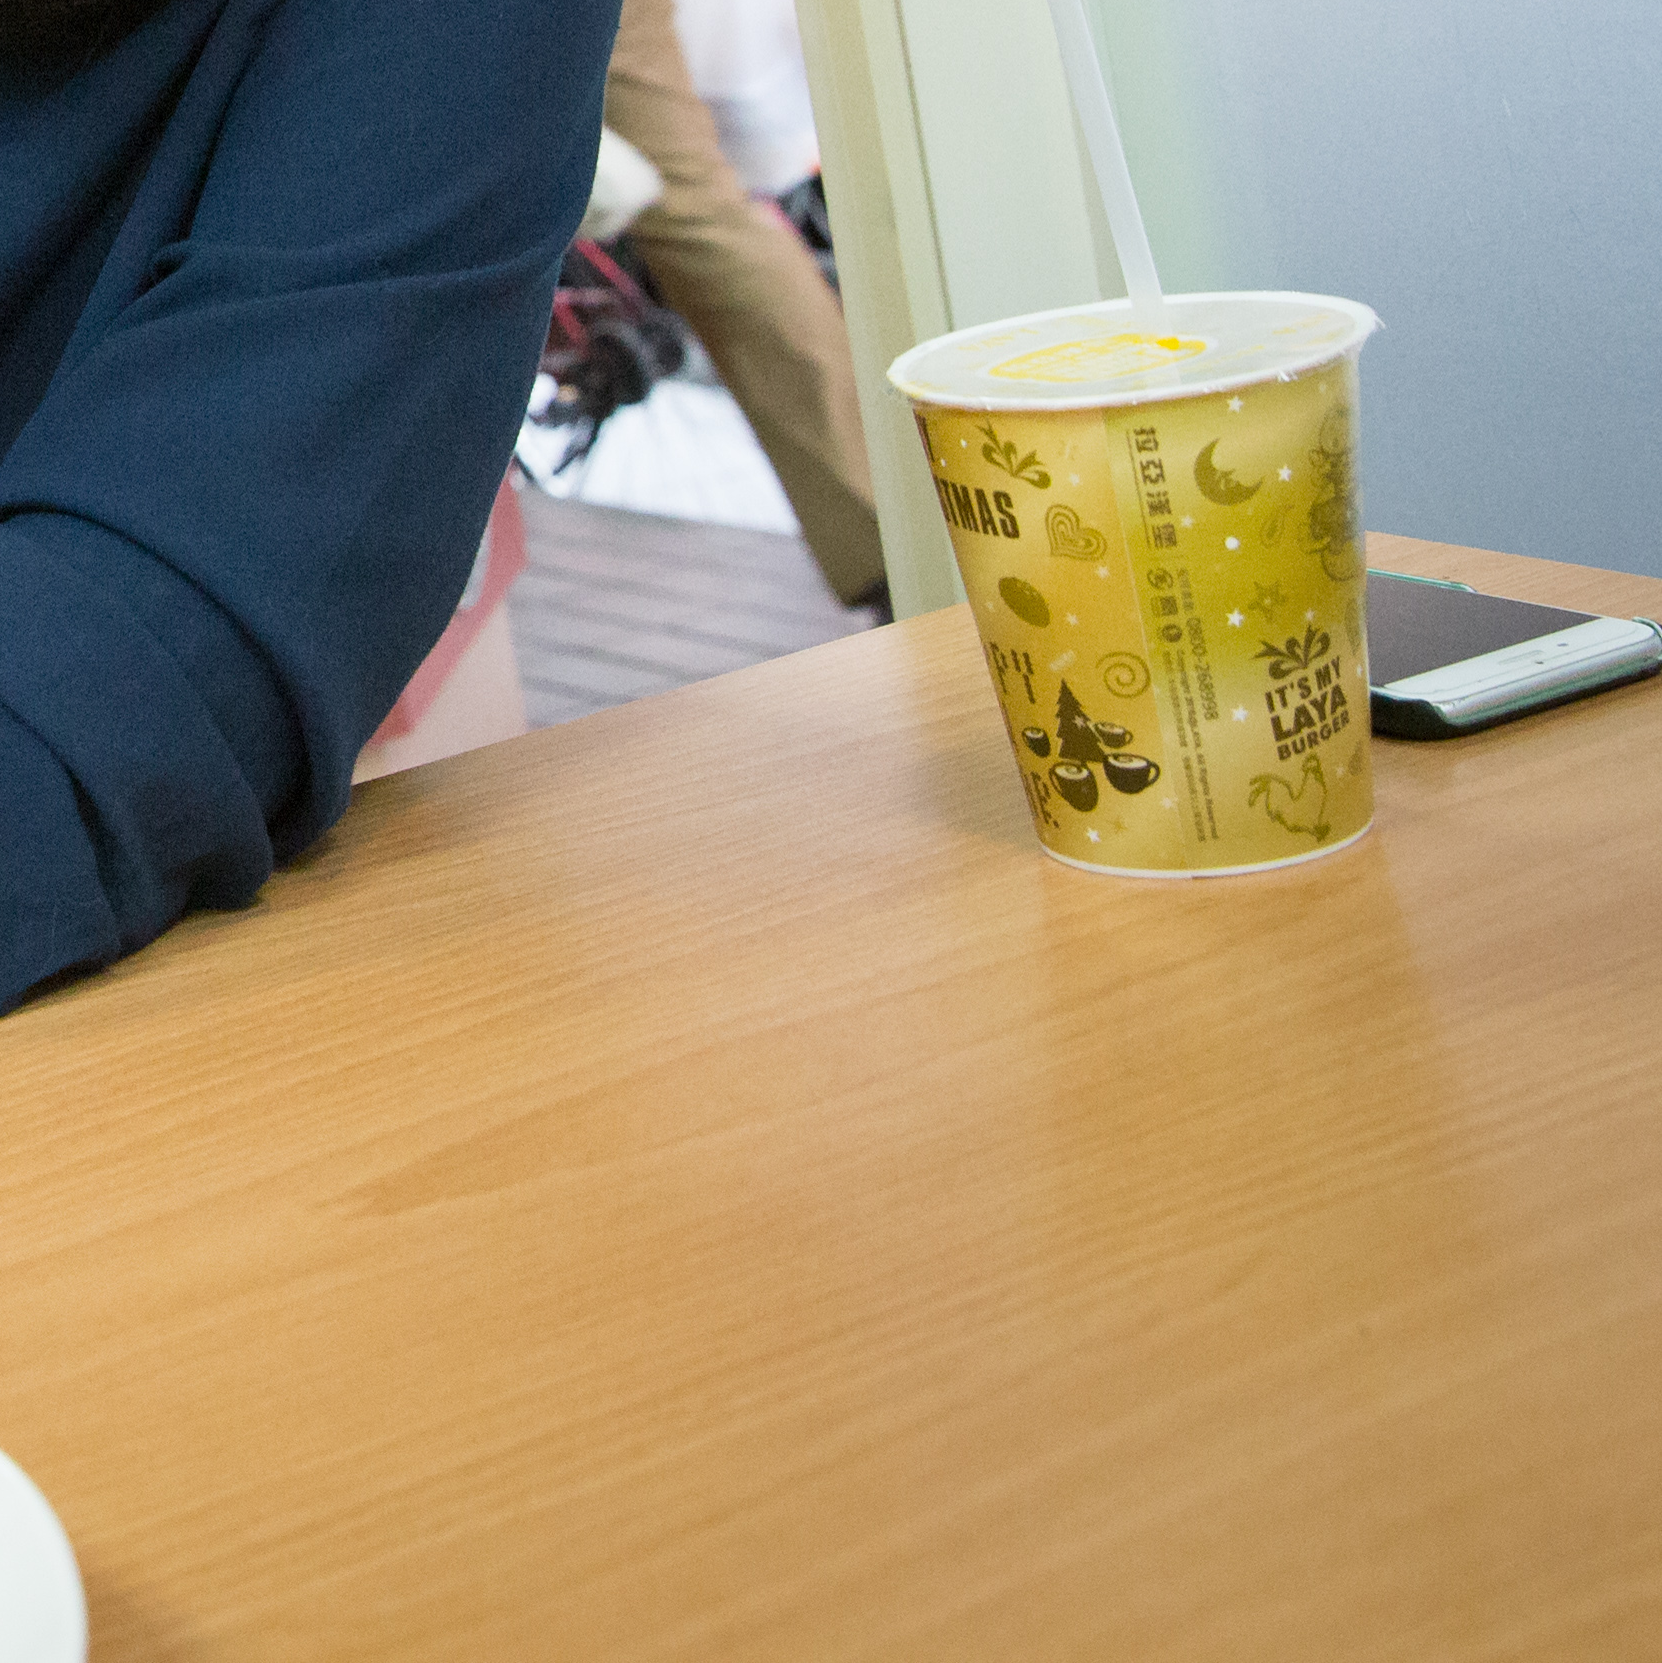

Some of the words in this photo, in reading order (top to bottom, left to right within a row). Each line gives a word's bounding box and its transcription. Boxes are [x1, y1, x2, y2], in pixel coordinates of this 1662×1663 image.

[932, 474, 1020, 540] TMAS
[1265, 676, 1312, 714] IT'S
[1315, 655, 1341, 691] MY
[1270, 684, 1347, 742] LAYA
[1277, 710, 1350, 761] BURGER
